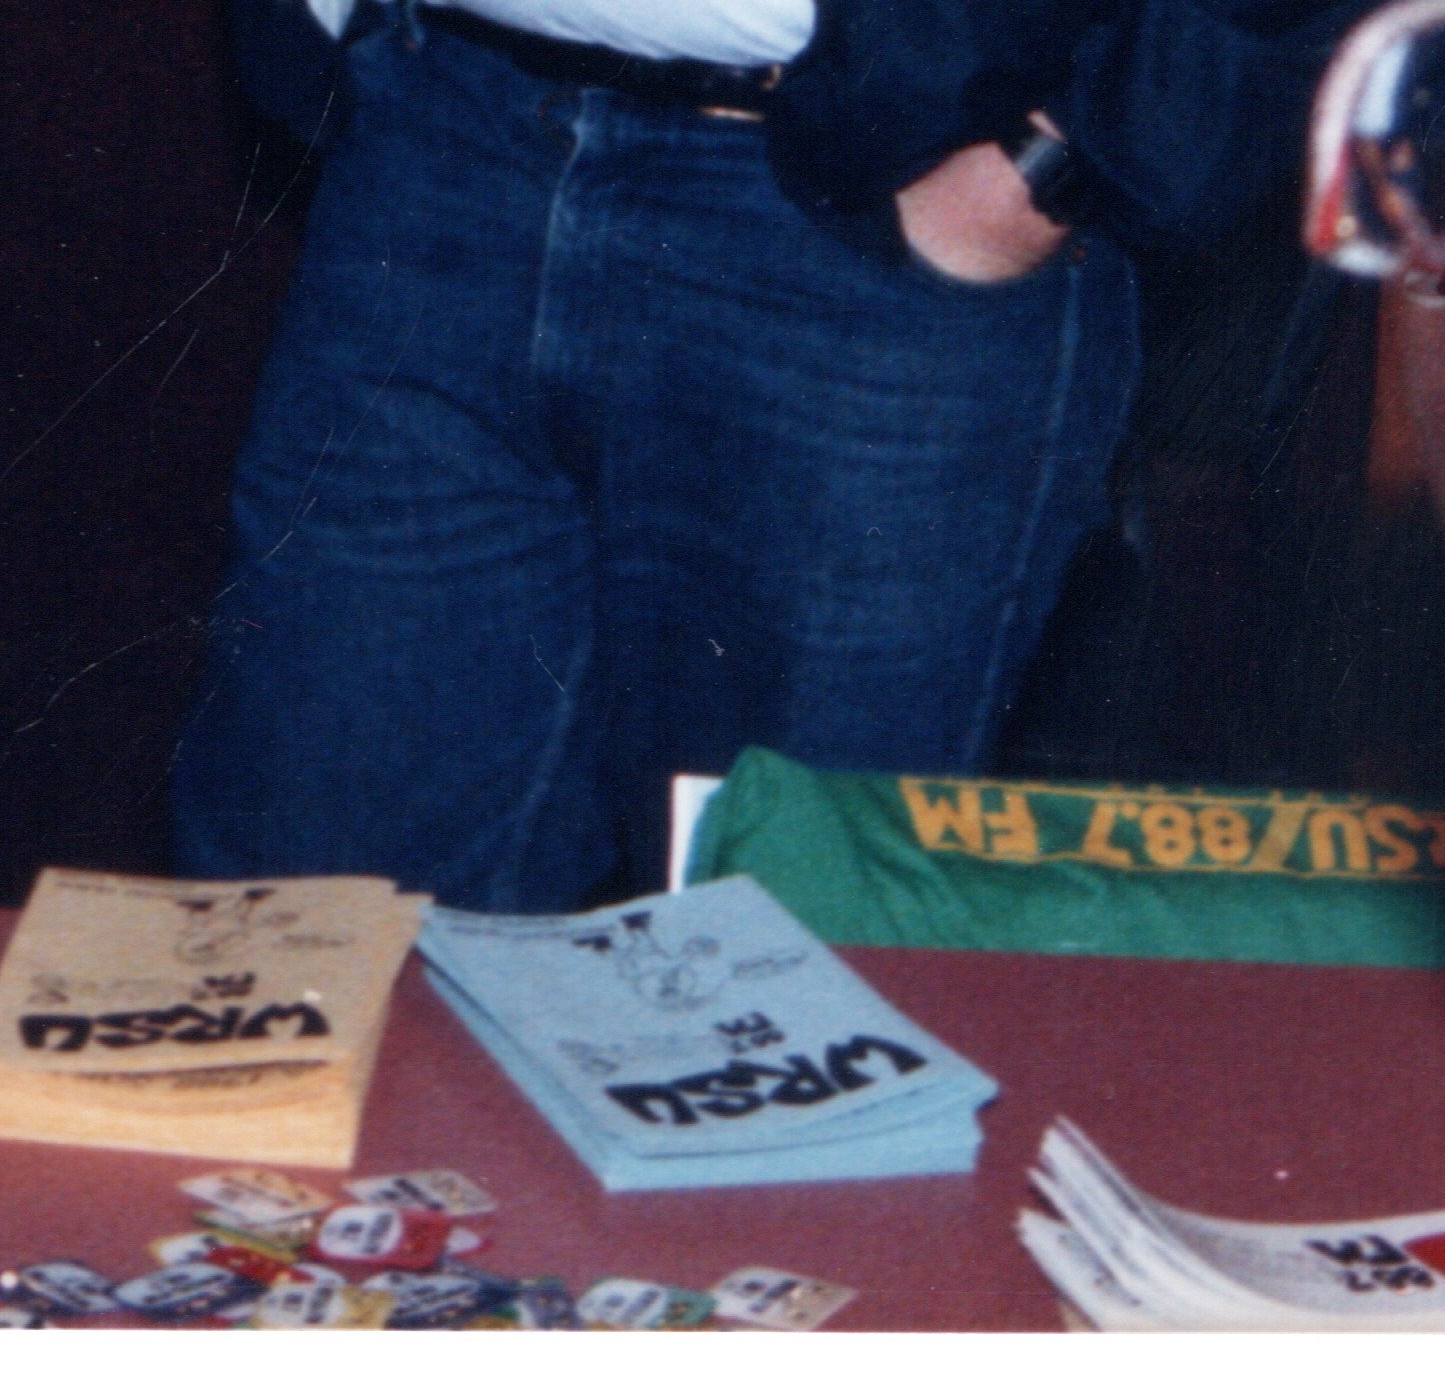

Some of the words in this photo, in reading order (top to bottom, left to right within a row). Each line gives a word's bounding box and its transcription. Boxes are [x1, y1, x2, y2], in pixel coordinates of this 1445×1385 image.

[900, 778, 1040, 862] FM
[19, 1003, 331, 1051] WRSU
[605, 1035, 928, 1125] WRSU
